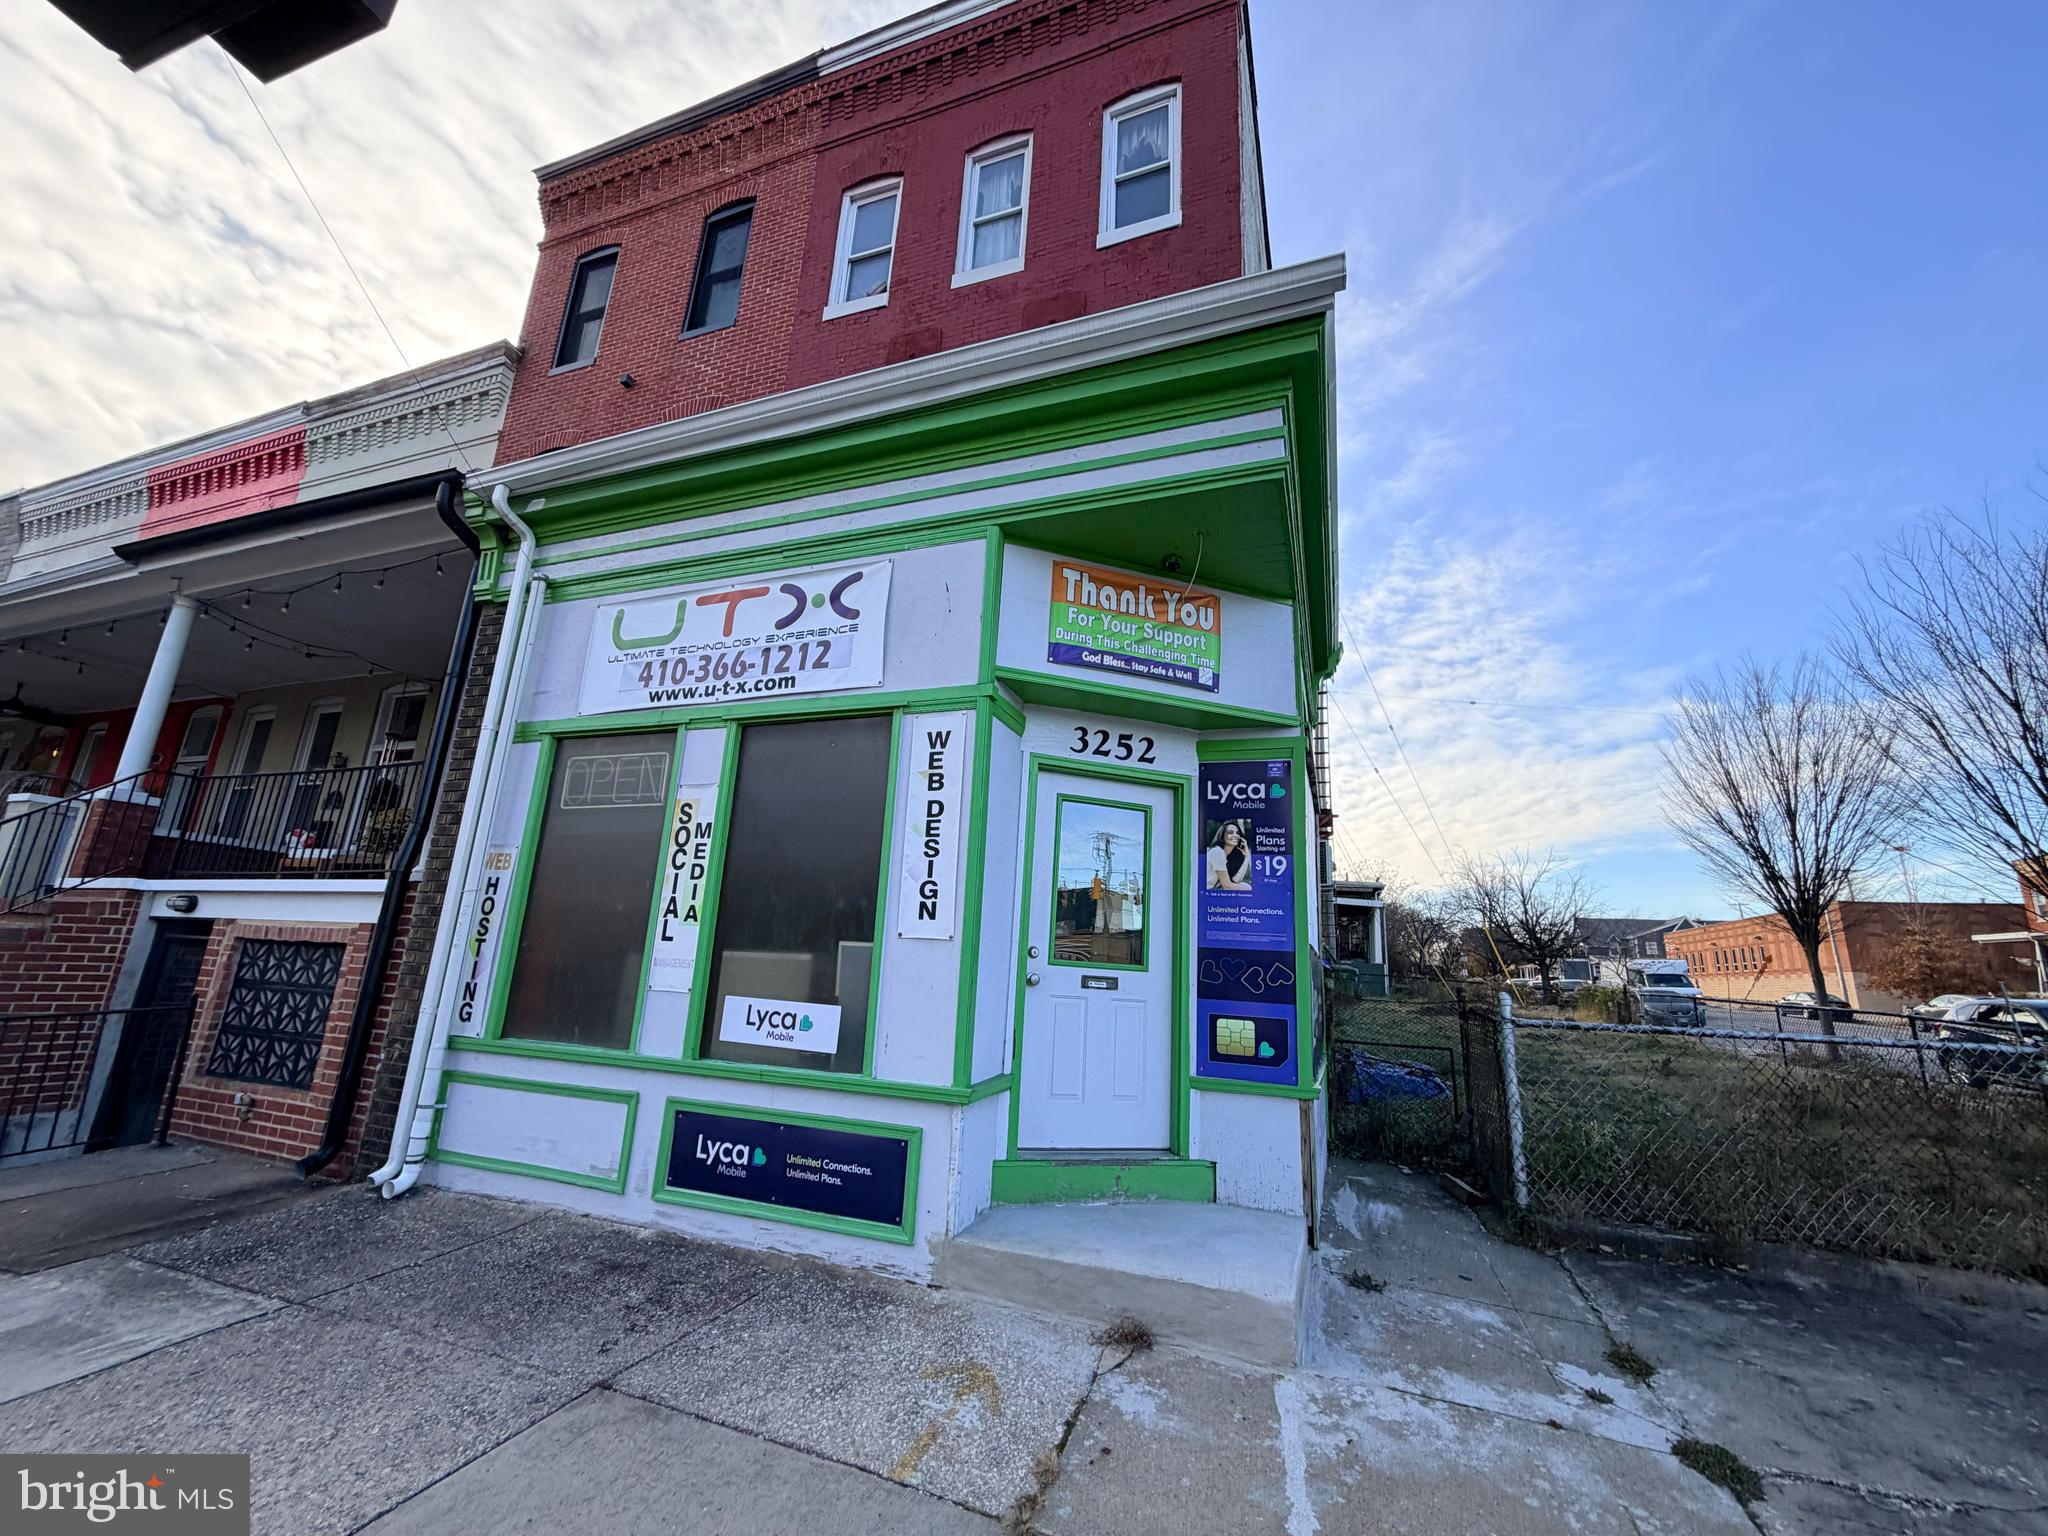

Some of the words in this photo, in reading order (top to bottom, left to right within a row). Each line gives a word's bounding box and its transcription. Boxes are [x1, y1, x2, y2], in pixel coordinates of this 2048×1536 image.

[1062, 567, 1156, 619] Thank
[1162, 590, 1214, 631] You
[1068, 606, 1096, 627] For
[1101, 613, 1138, 636] Your
[1143, 622, 1206, 650] Support
[607, 649, 665, 664] ULTIMATE
[671, 636, 760, 656] TECHNOLOGY
[765, 623, 859, 643] EXPERIENCE
[1056, 627, 1093, 646] During
[1097, 634, 1120, 649] This
[1124, 640, 1187, 664] Challenging
[1191, 653, 1216, 669] Time
[638, 640, 832, 688] 410-366-1212
[1082, 652, 1101, 664] God
[1132, 662, 1149, 674] Stay
[1150, 664, 1166, 676] Safe
[1167, 668, 1174, 677] &
[1175, 670, 1192, 680] Well
[649, 674, 796, 703] www.u-t-x.com
[1069, 726, 1156, 764] 3252
[927, 730, 951, 791] WEB
[566, 756, 666, 805] OPEN
[1207, 780, 1266, 803] Lyca
[1233, 801, 1266, 809] Mobile
[1256, 835, 1285, 845] Plans
[660, 802, 693, 942] SOCIAL
[683, 822, 712, 922] MEDIA
[918, 799, 945, 920] DESIGN
[1255, 856, 1287, 876] $19
[1240, 906, 1285, 915] Connections.
[1240, 916, 1261, 924] Plans.
[459, 876, 500, 1023] HOSTING
[746, 1004, 797, 1031] Lyca
[766, 1030, 794, 1042] Mobile
[696, 1134, 750, 1166] Lyca
[786, 1154, 821, 1168] Unlimited
[822, 1160, 873, 1176] Connections.
[717, 1164, 747, 1178] Mobile
[786, 1168, 820, 1182] Unlimited
[820, 1174, 842, 1186] Plans.
